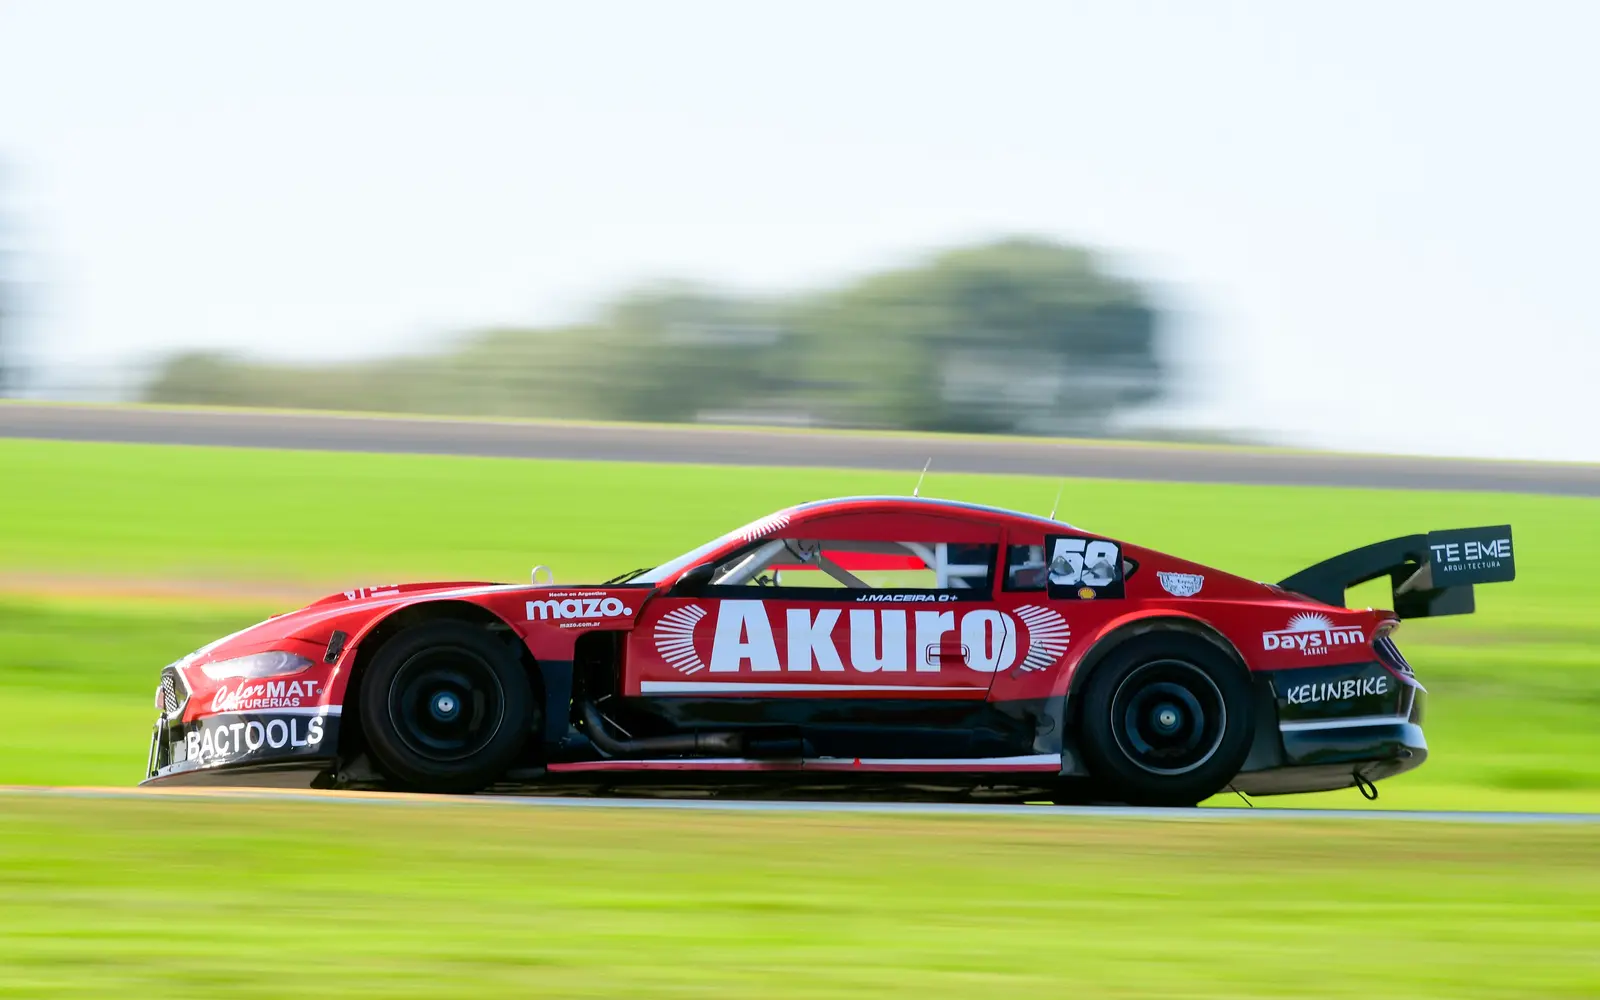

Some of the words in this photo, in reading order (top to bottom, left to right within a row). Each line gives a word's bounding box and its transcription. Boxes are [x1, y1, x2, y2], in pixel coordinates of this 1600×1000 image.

[1430, 543, 1460, 563] TE
[1464, 539, 1511, 560] EME
[1443, 561, 1501, 572] ARQUITECTURA
[856, 594, 936, 602] J.MACEIRA
[559, 621, 601, 629] mazo.com.ar
[709, 600, 1017, 673] Akuro
[1263, 632, 1323, 650] Days
[1326, 630, 1365, 645] Inn
[1287, 676, 1388, 705] KELINBIKE
[187, 716, 324, 762] BACTOOLS
